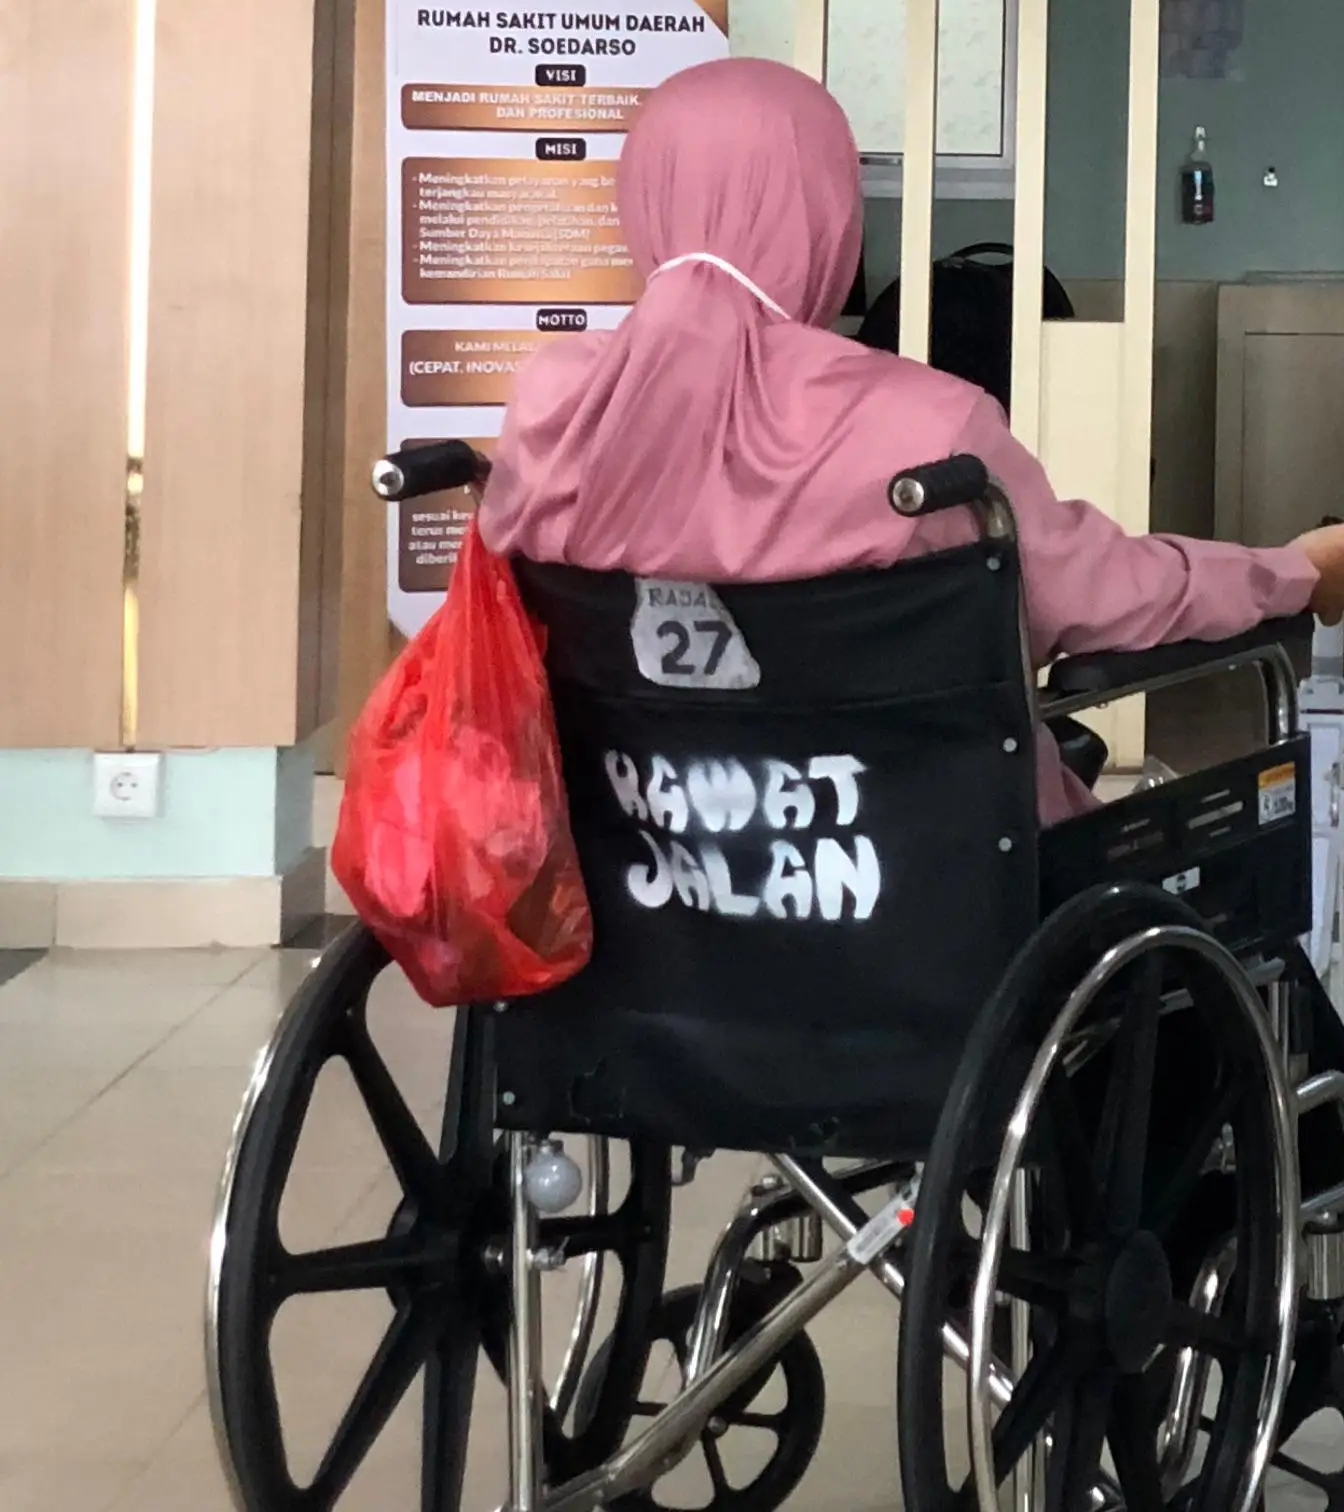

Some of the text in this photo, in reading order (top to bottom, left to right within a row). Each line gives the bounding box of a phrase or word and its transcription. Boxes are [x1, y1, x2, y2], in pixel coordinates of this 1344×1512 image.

[417, 8, 706, 33] RUMAH SAKIT UMUM DAERAH
[489, 36, 636, 56] DR. SOEDARSO
[545, 69, 577, 82] VISI
[411, 90, 475, 103] MENJADI
[480, 91, 531, 105] RUMAH
[533, 92, 575, 106] SAKIT
[496, 106, 624, 120] DAN PROFESIONAL
[545, 143, 577, 155] MISI
[538, 313, 586, 326] MOTTO
[454, 340, 491, 352] KAMI
[648, 587, 708, 608] RAJA
[656, 620, 733, 676] 27
[603, 748, 868, 834] RAWAT
[626, 828, 881, 921] JALAN
